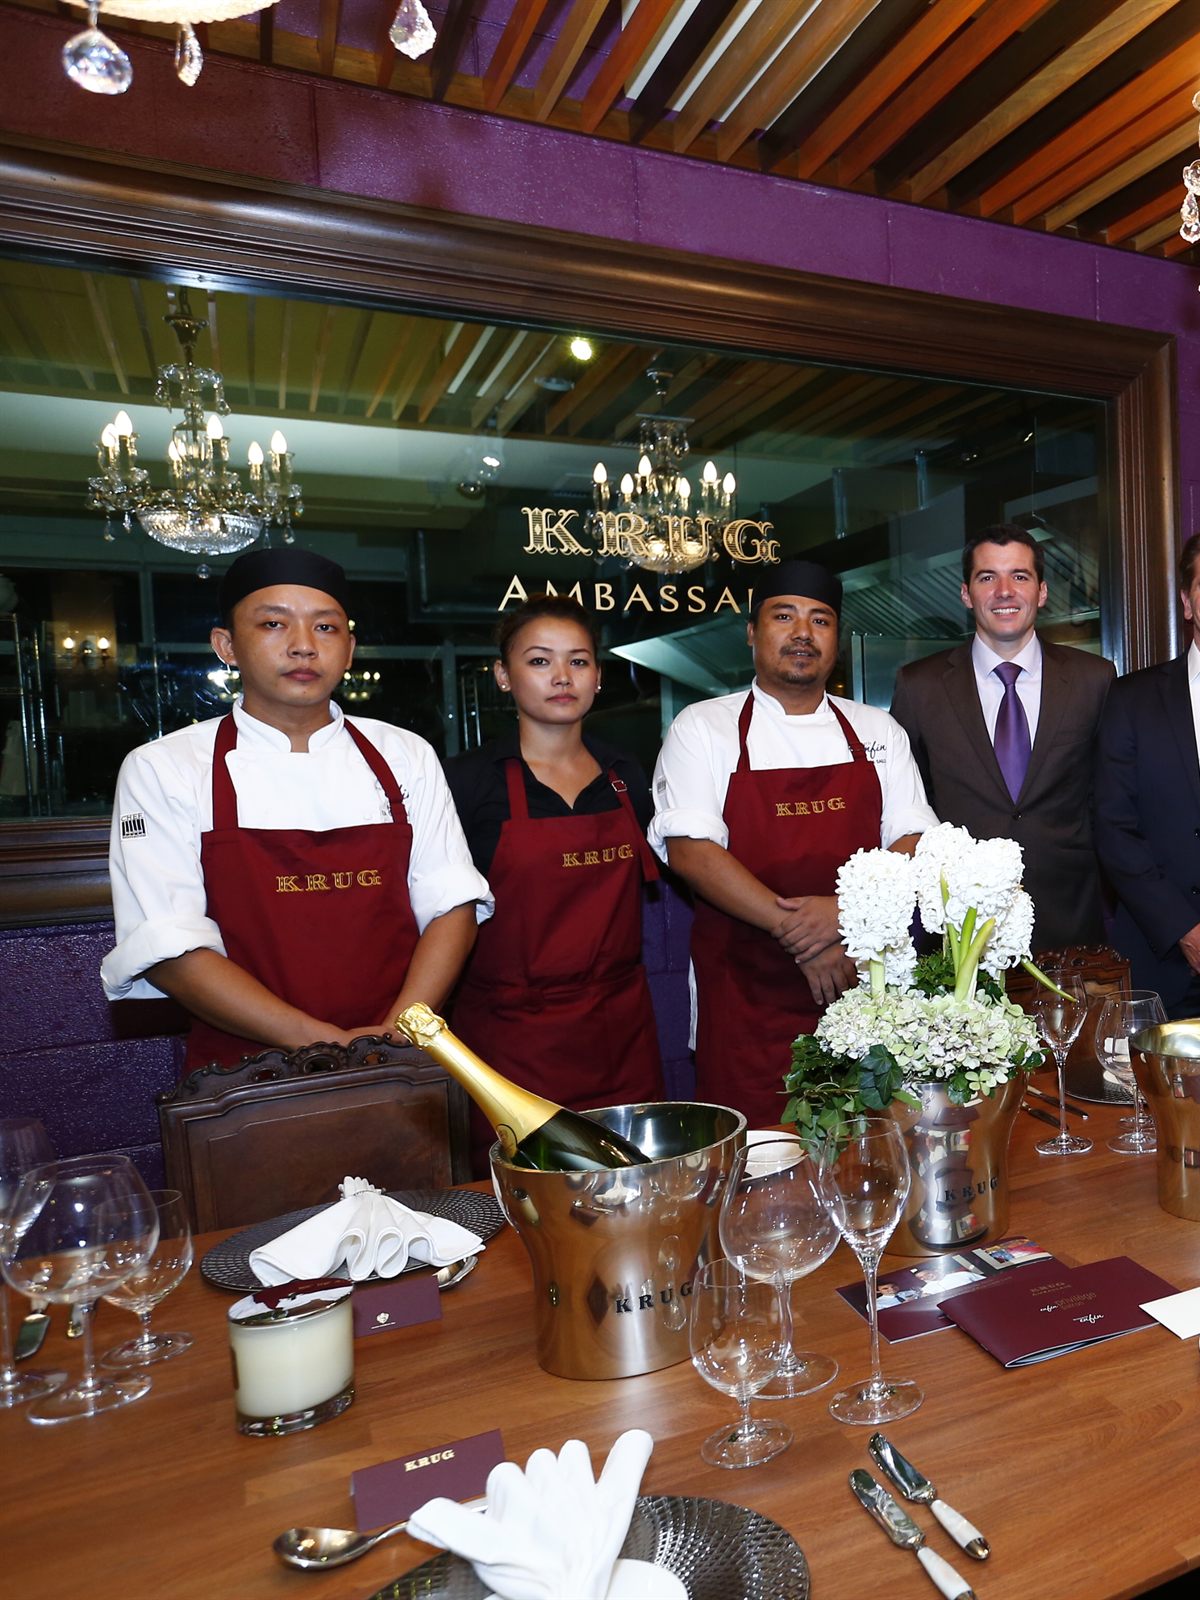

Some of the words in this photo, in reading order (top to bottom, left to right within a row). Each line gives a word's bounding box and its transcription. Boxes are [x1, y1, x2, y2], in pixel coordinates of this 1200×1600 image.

[520, 506, 782, 564] KRUG
[498, 574, 754, 615] AMBASSA
[775, 797, 847, 817] KRUG
[562, 844, 635, 867] KRUG
[275, 869, 382, 893] KRUG
[944, 1176, 998, 1201] KRUG
[615, 1281, 694, 1314] KRUG
[404, 1449, 457, 1473] KRUG
